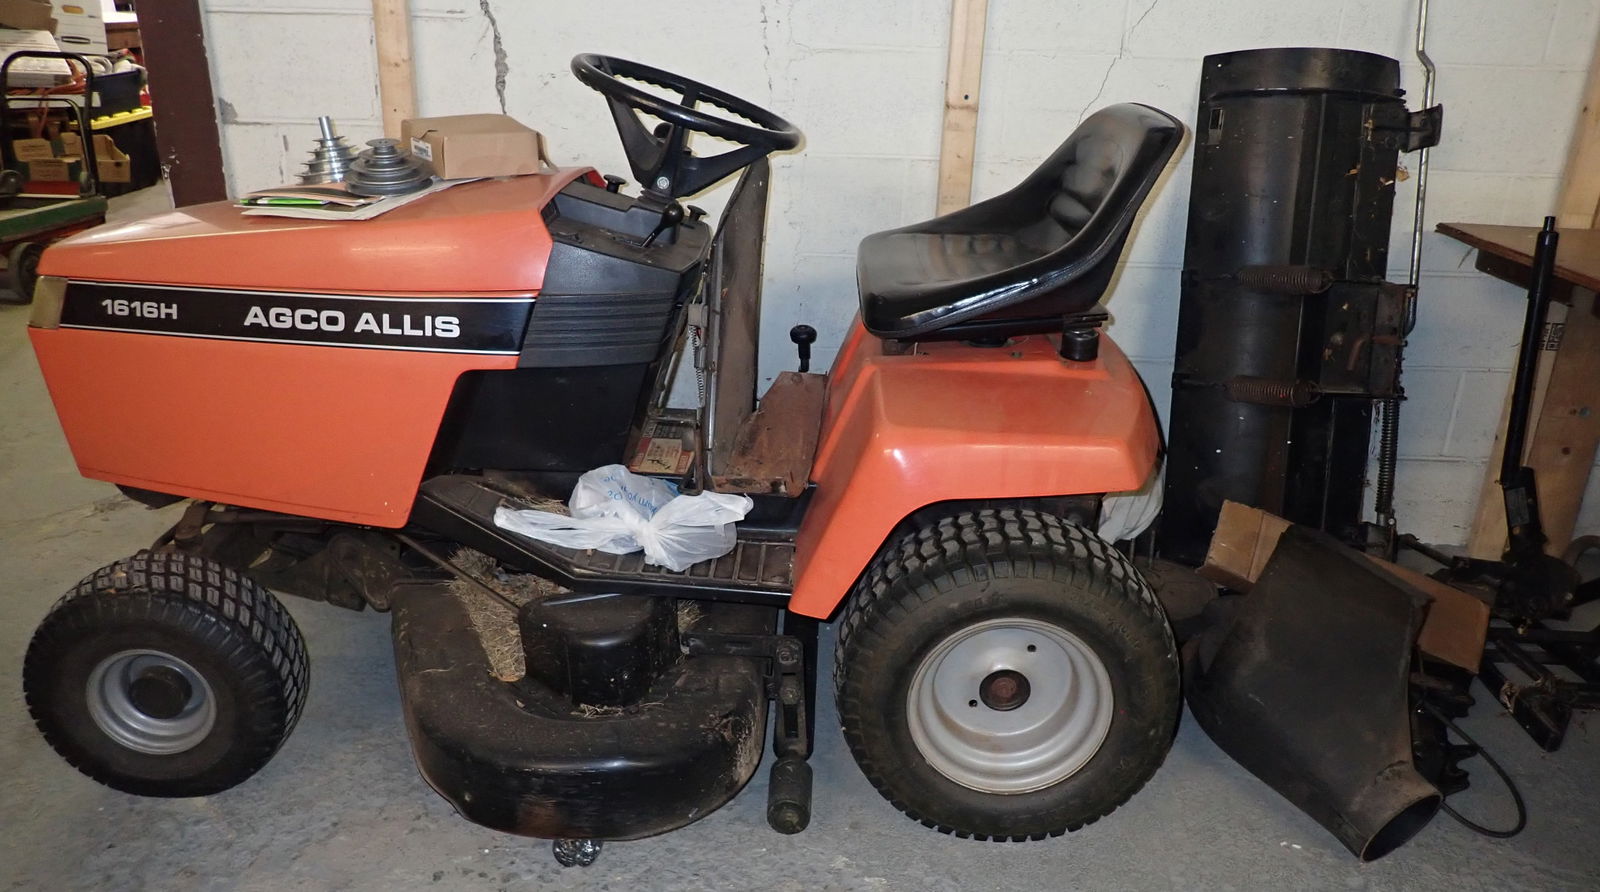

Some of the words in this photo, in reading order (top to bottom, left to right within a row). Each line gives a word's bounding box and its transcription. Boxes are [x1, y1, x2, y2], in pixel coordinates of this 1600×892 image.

[101, 299, 178, 320] 1616H
[243, 305, 346, 332] AGCO
[353, 312, 461, 338] ALLIS
